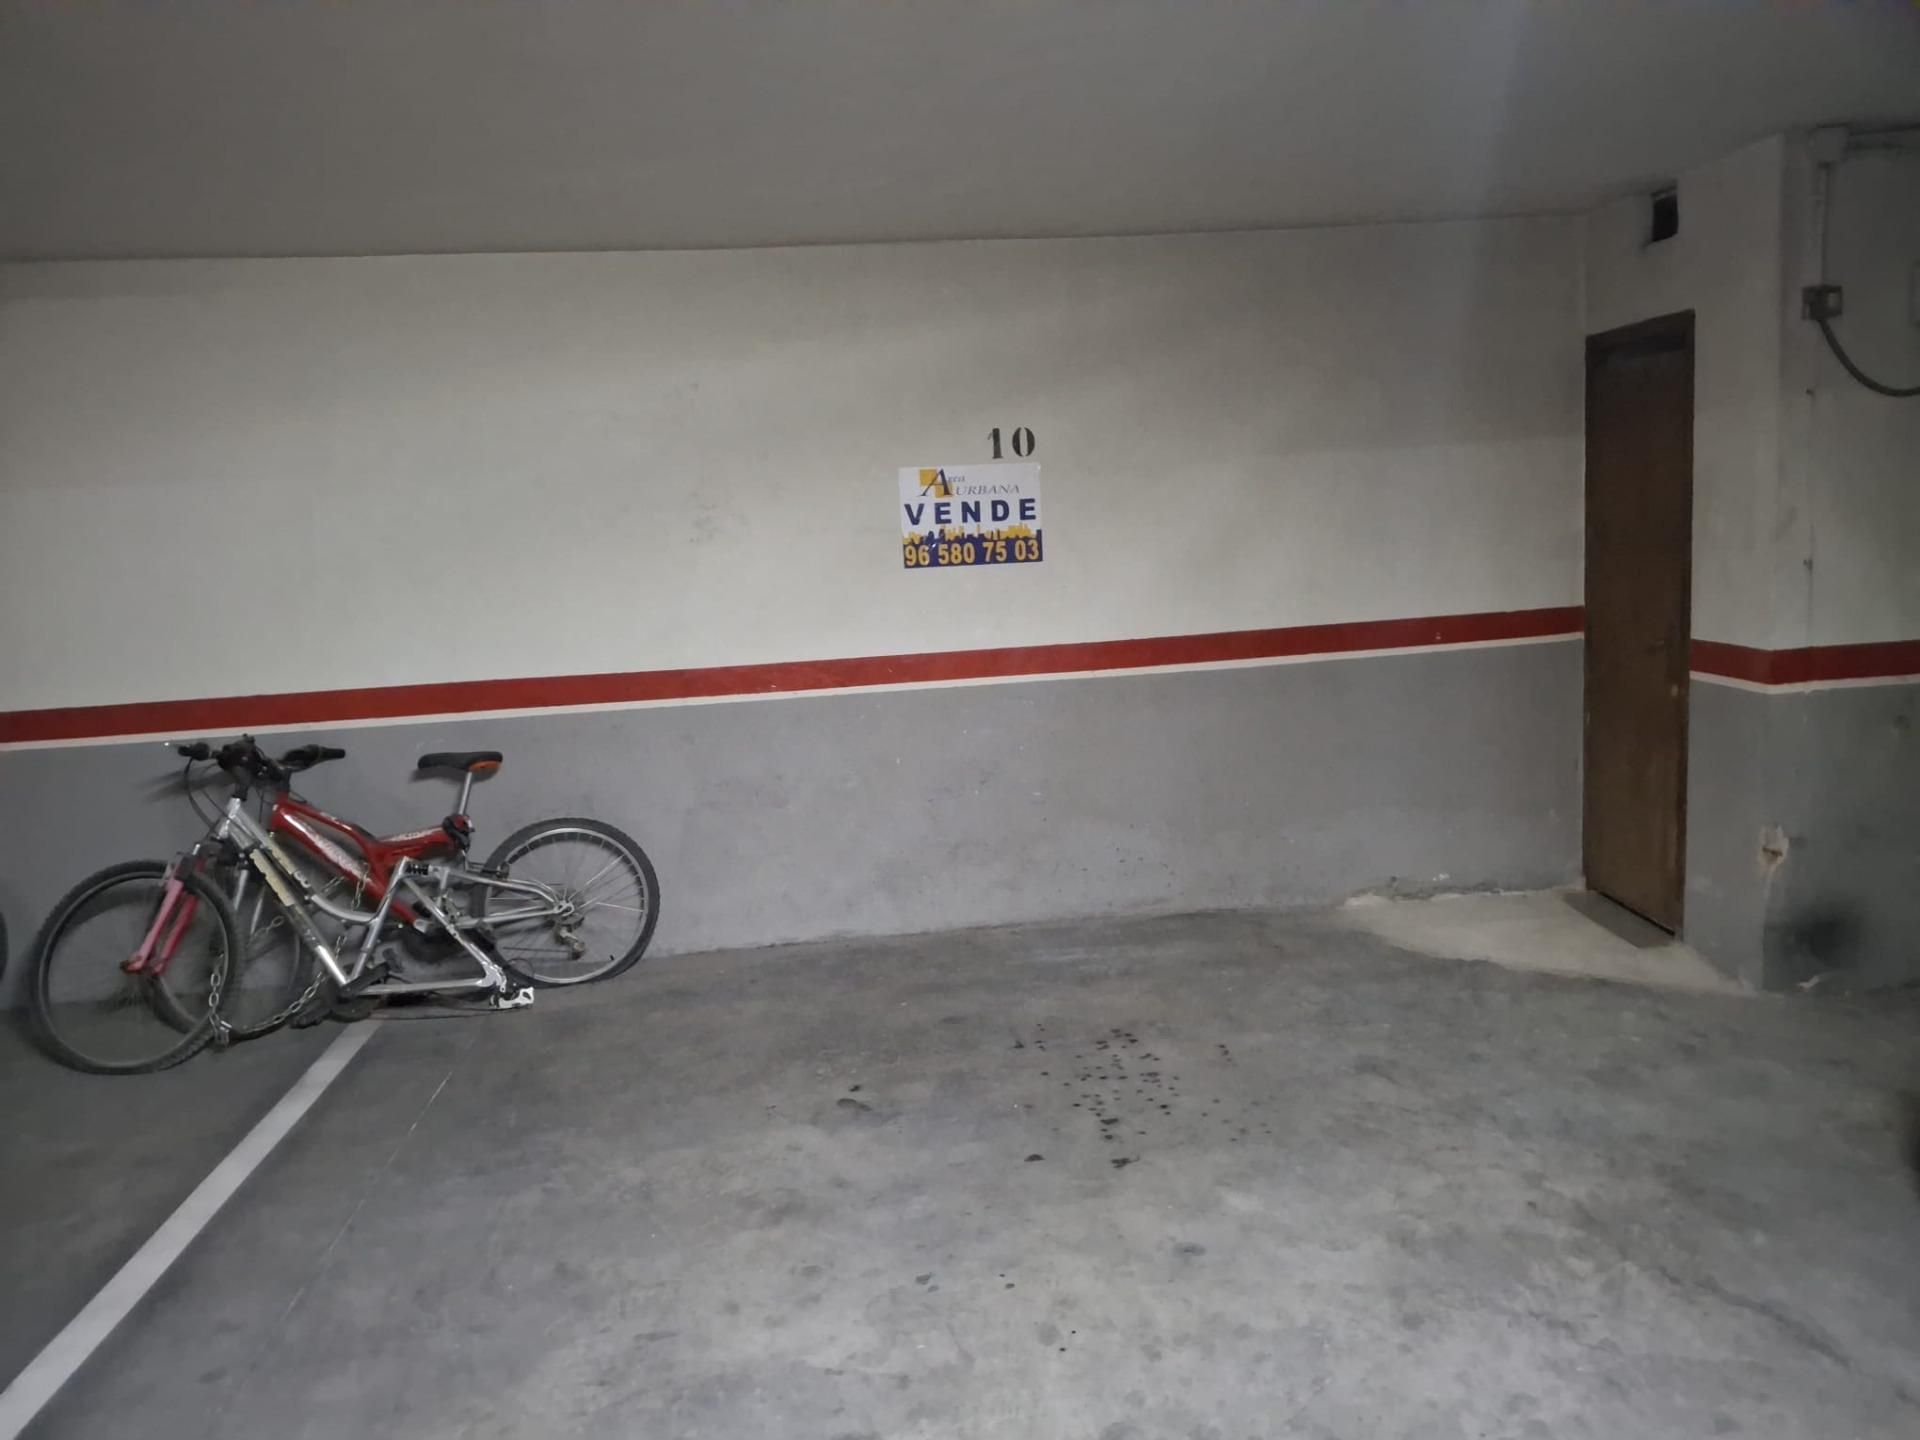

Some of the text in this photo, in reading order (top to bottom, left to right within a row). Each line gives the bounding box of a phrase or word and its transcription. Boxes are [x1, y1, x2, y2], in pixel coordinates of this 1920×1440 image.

[987, 426, 1036, 459] 10
[955, 484, 1020, 496] URBANA
[904, 498, 1037, 526] VENDE
[905, 538, 1040, 567] 96 580 75 03
